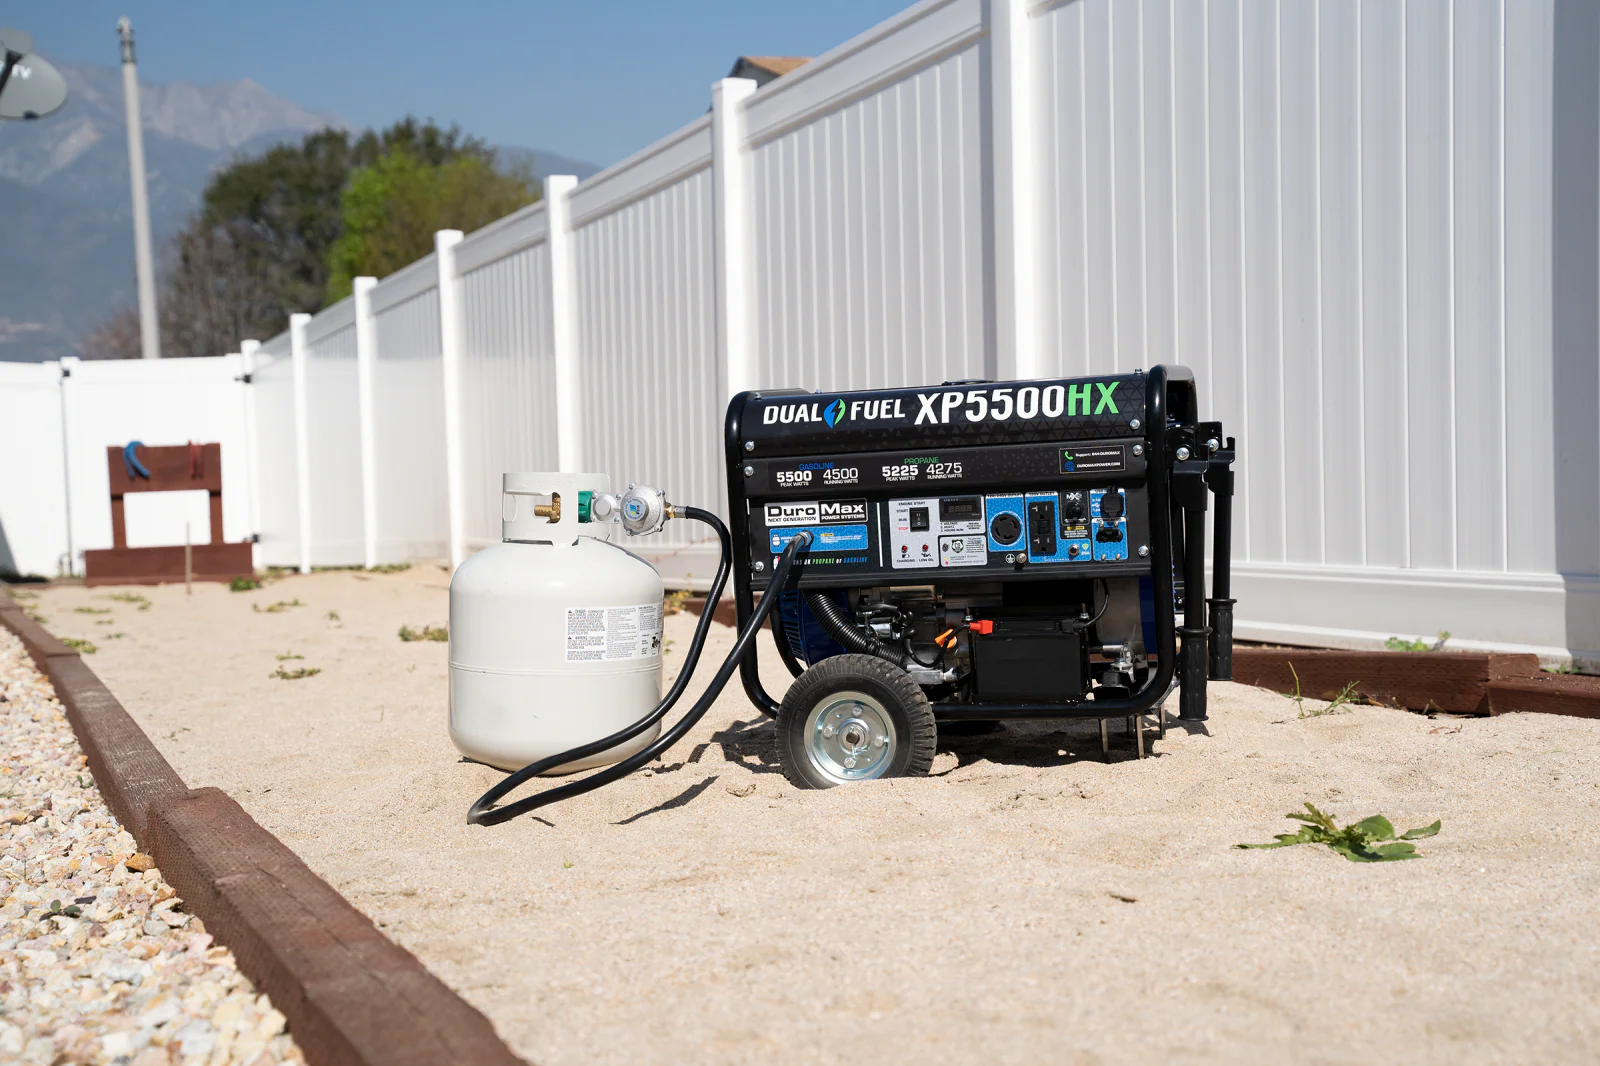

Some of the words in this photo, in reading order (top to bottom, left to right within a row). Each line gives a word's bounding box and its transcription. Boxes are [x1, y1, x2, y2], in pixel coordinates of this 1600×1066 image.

[763, 403, 823, 425] DUAL
[850, 398, 906, 421] FUEL
[913, 381, 1121, 426] XP5500HX
[798, 462, 835, 471] GASOLINE
[903, 456, 939, 465] PROPANE
[776, 470, 812, 483] 5500
[822, 467, 859, 480] 4500
[881, 464, 919, 477] 5225
[925, 462, 963, 475] 4275
[768, 506, 816, 517] Duro
[821, 503, 864, 515] Max
[812, 557, 835, 565] PROPANE
[843, 556, 868, 564] GASOLINE
